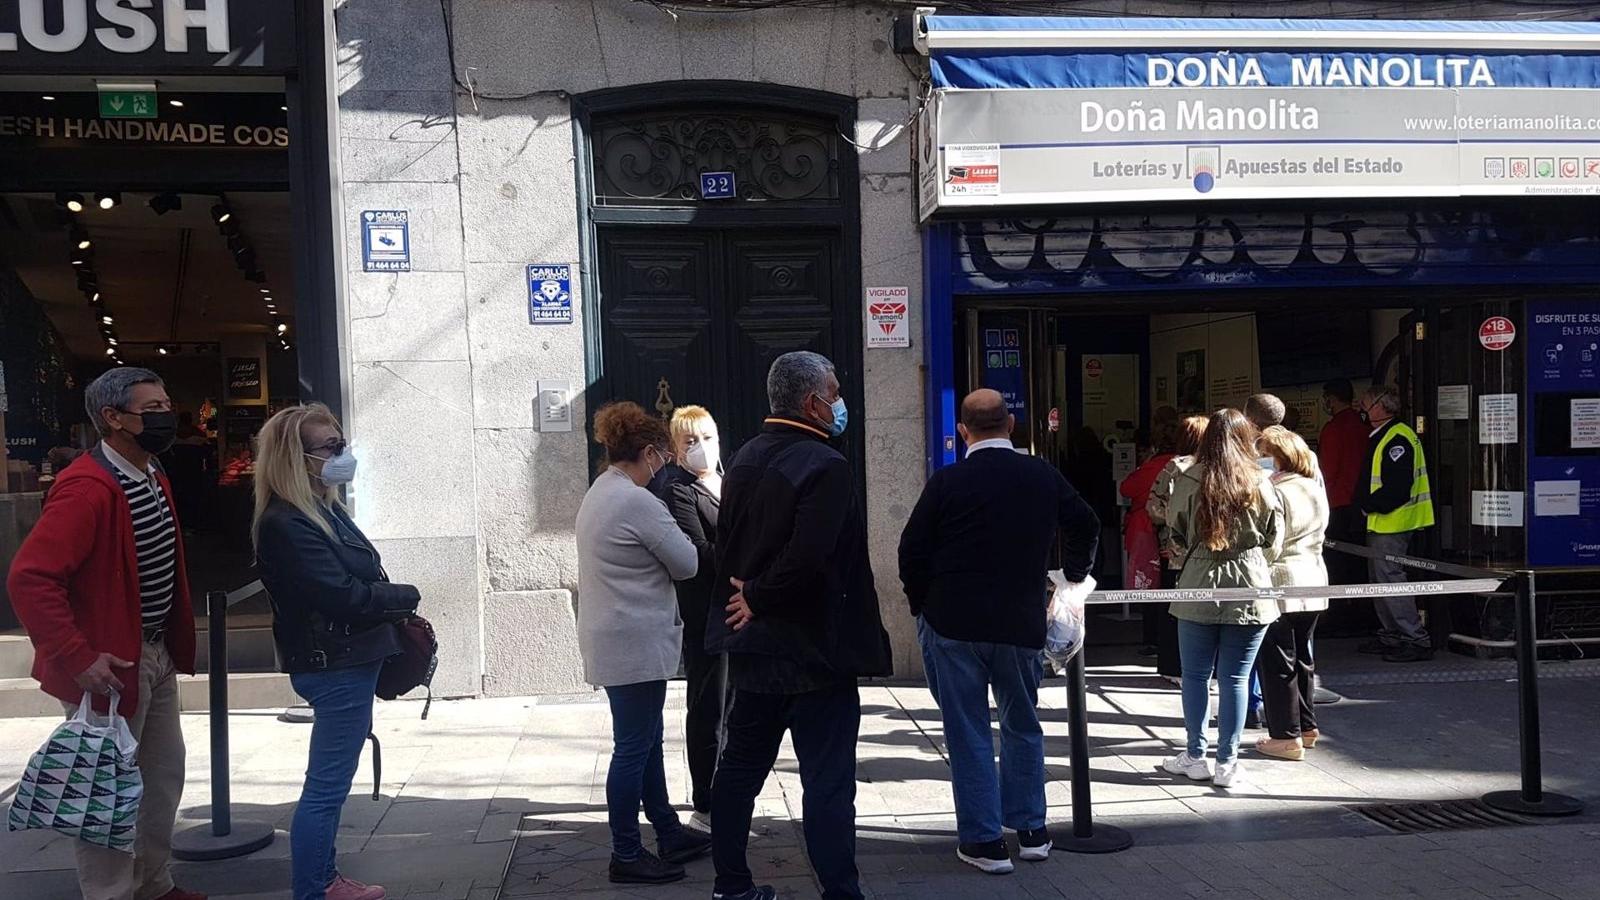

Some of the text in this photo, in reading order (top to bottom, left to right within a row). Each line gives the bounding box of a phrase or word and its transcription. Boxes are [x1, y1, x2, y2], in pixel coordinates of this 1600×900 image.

[0, 0, 230, 53] USH
[1147, 50, 1496, 86] DOÑA MANOLITA
[1080, 98, 1319, 133] Doña Manolita
[65, 118, 226, 144] HANDMADE
[1093, 157, 1403, 180] Loterías y Apuestas del Estado
[707, 177, 729, 193] 22
[951, 184, 967, 193] 24h
[1524, 185, 1583, 194] Administración
[532, 266, 567, 275] CARLÚS
[1535, 314, 1577, 323] DISFRUTE
[1578, 314, 1590, 323] DE
[1485, 319, 1506, 331] +18
[1562, 326, 1600, 336] EN 3 PAS
[1345, 584, 1444, 595] WWW.LOTERIAMANOLITA.COM
[1105, 591, 1213, 601] WWW.LOTERIAMANOLITA.COM
